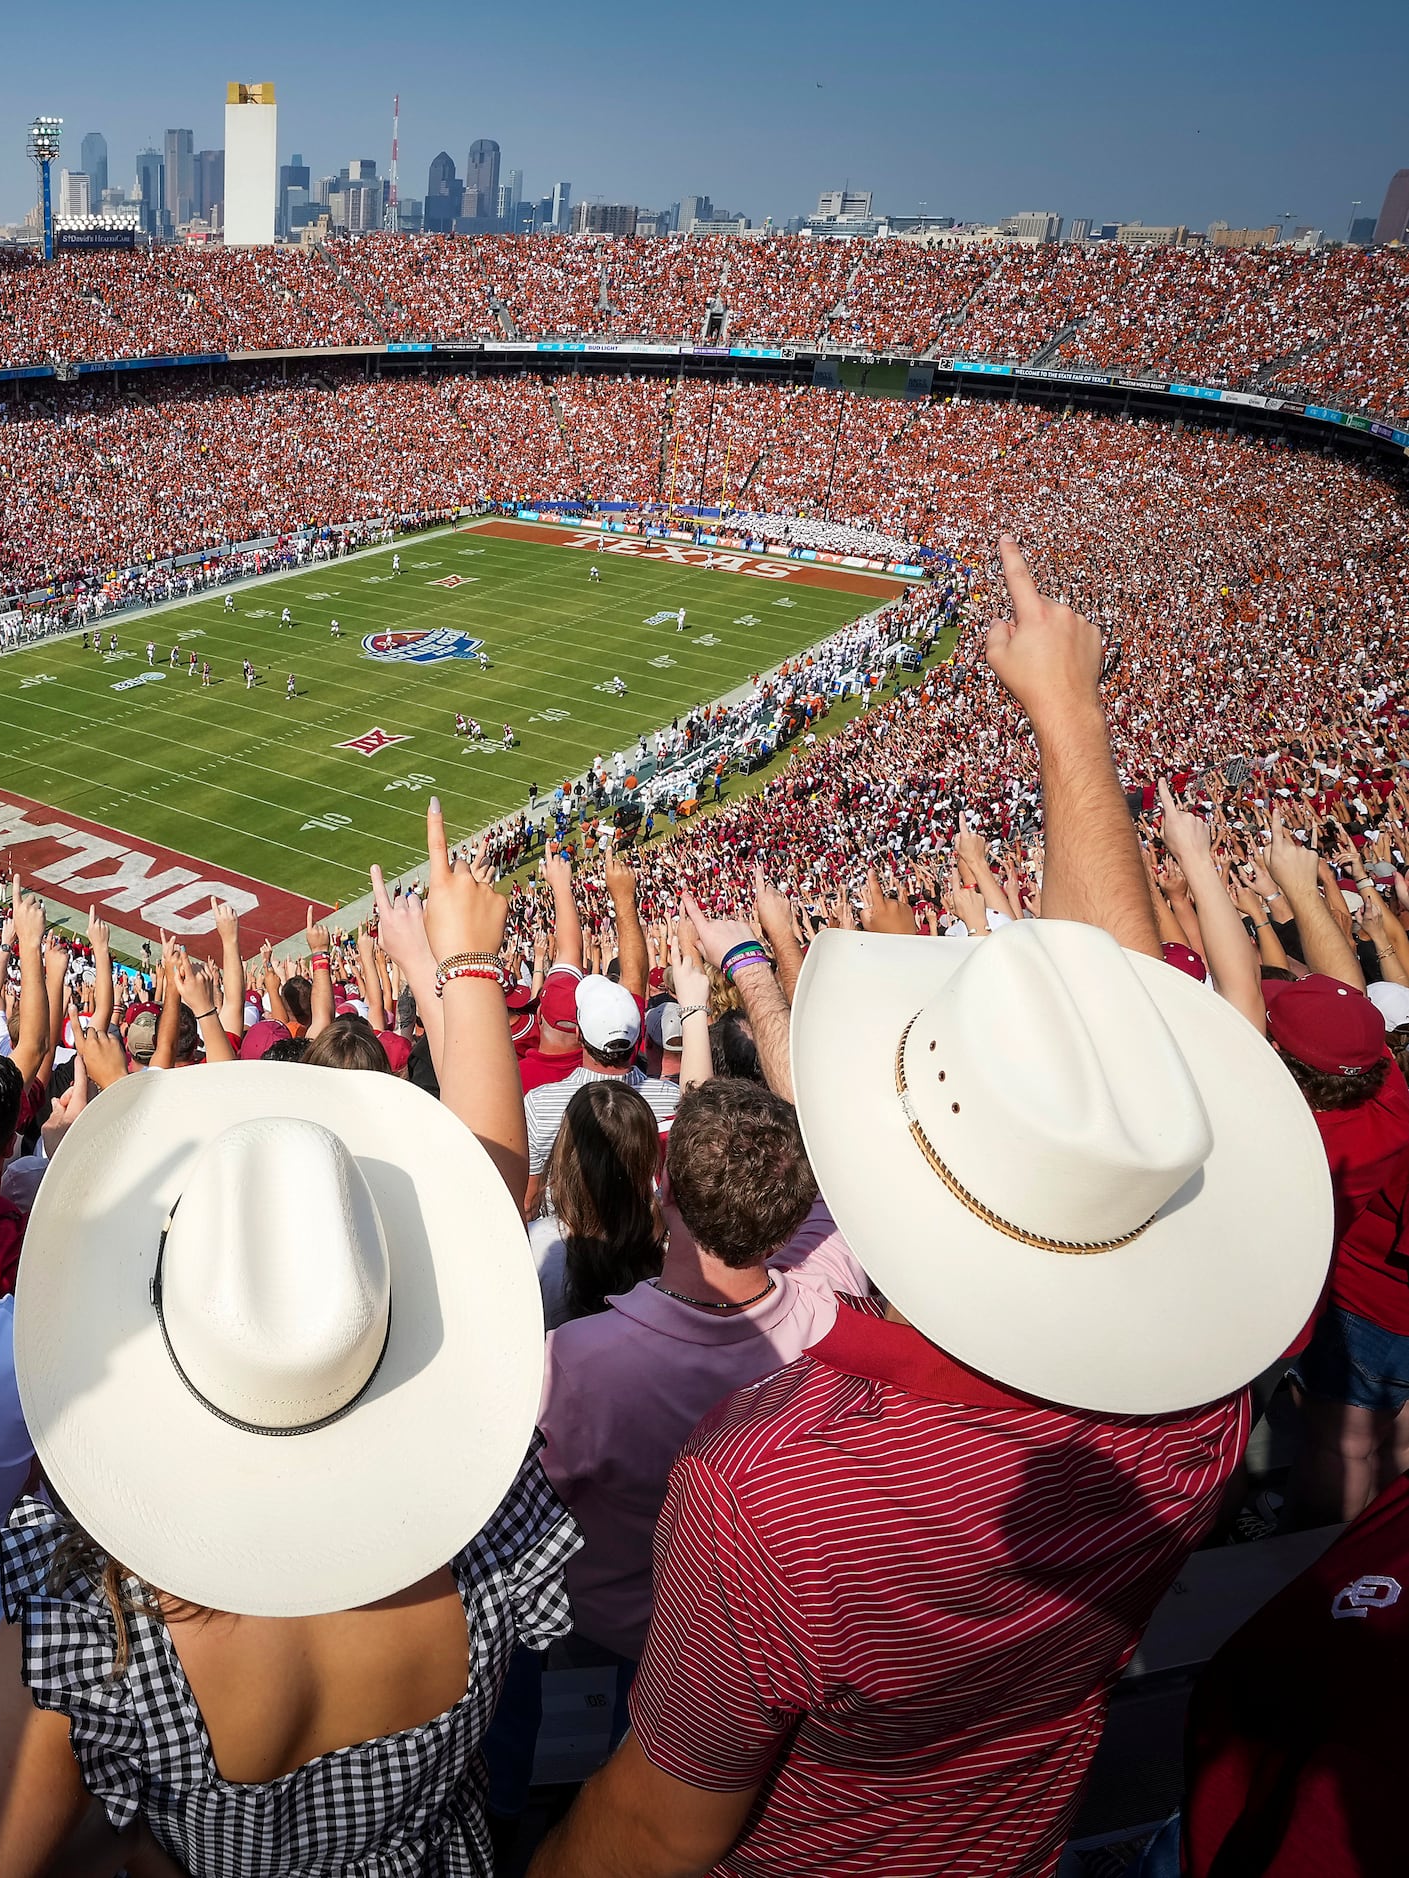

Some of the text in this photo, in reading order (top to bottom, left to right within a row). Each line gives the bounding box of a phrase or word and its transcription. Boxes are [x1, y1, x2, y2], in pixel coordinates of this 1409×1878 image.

[941, 359, 953, 369] 23
[1015, 369, 1040, 377] WELCOME
[563, 533, 803, 580] TEXAS
[395, 772, 437, 792] 20
[307, 812, 353, 832] 10
[1330, 1574, 1403, 1620] OU
